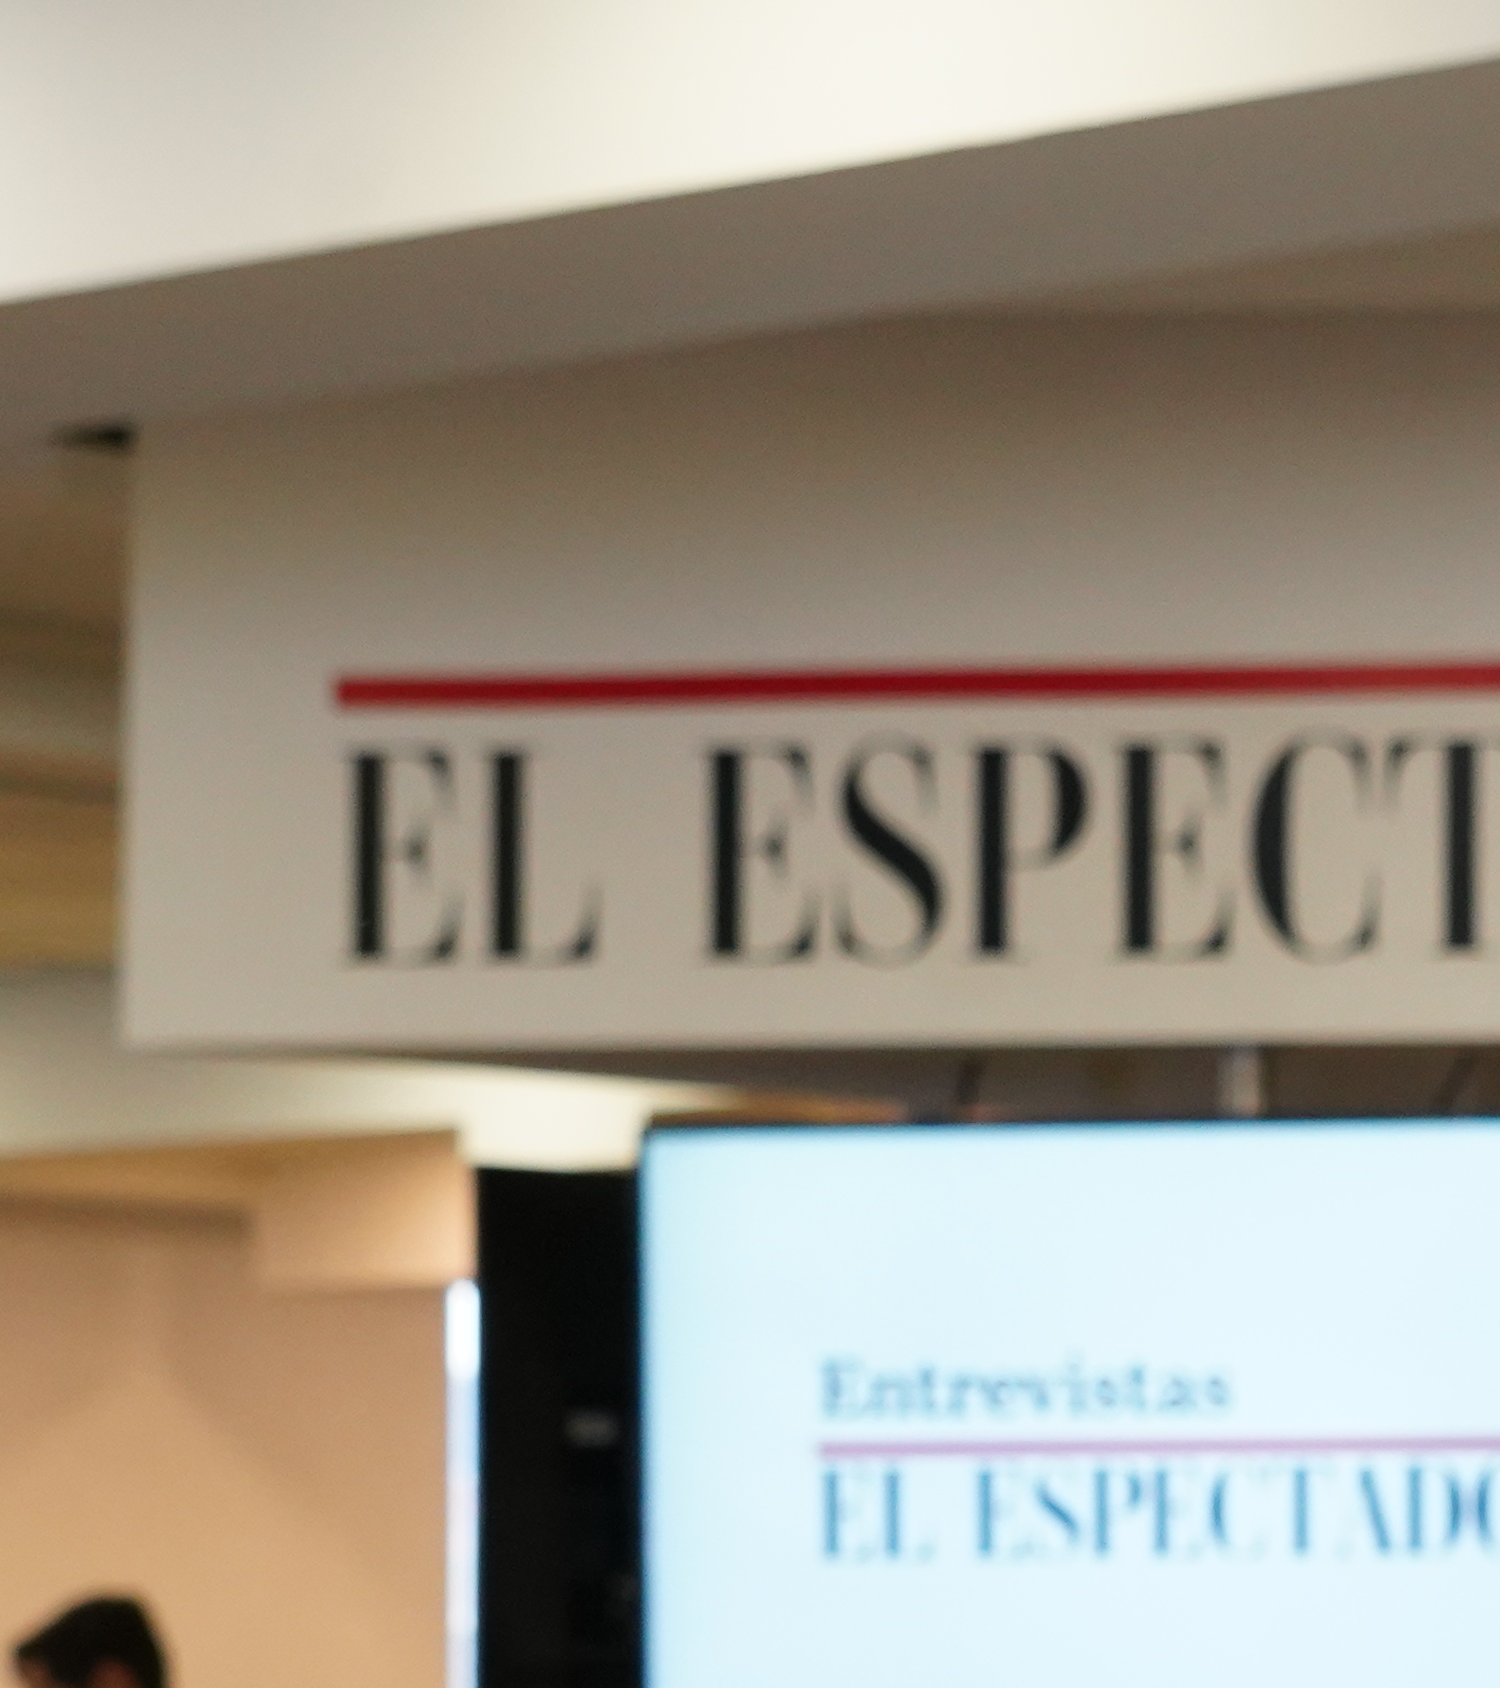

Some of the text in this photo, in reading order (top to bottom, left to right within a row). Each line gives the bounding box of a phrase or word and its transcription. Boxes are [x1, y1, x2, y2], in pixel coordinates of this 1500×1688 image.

[342, 738, 602, 966] EL
[819, 1358, 1233, 1422] Entrevistas
[820, 1466, 934, 1562] EL
